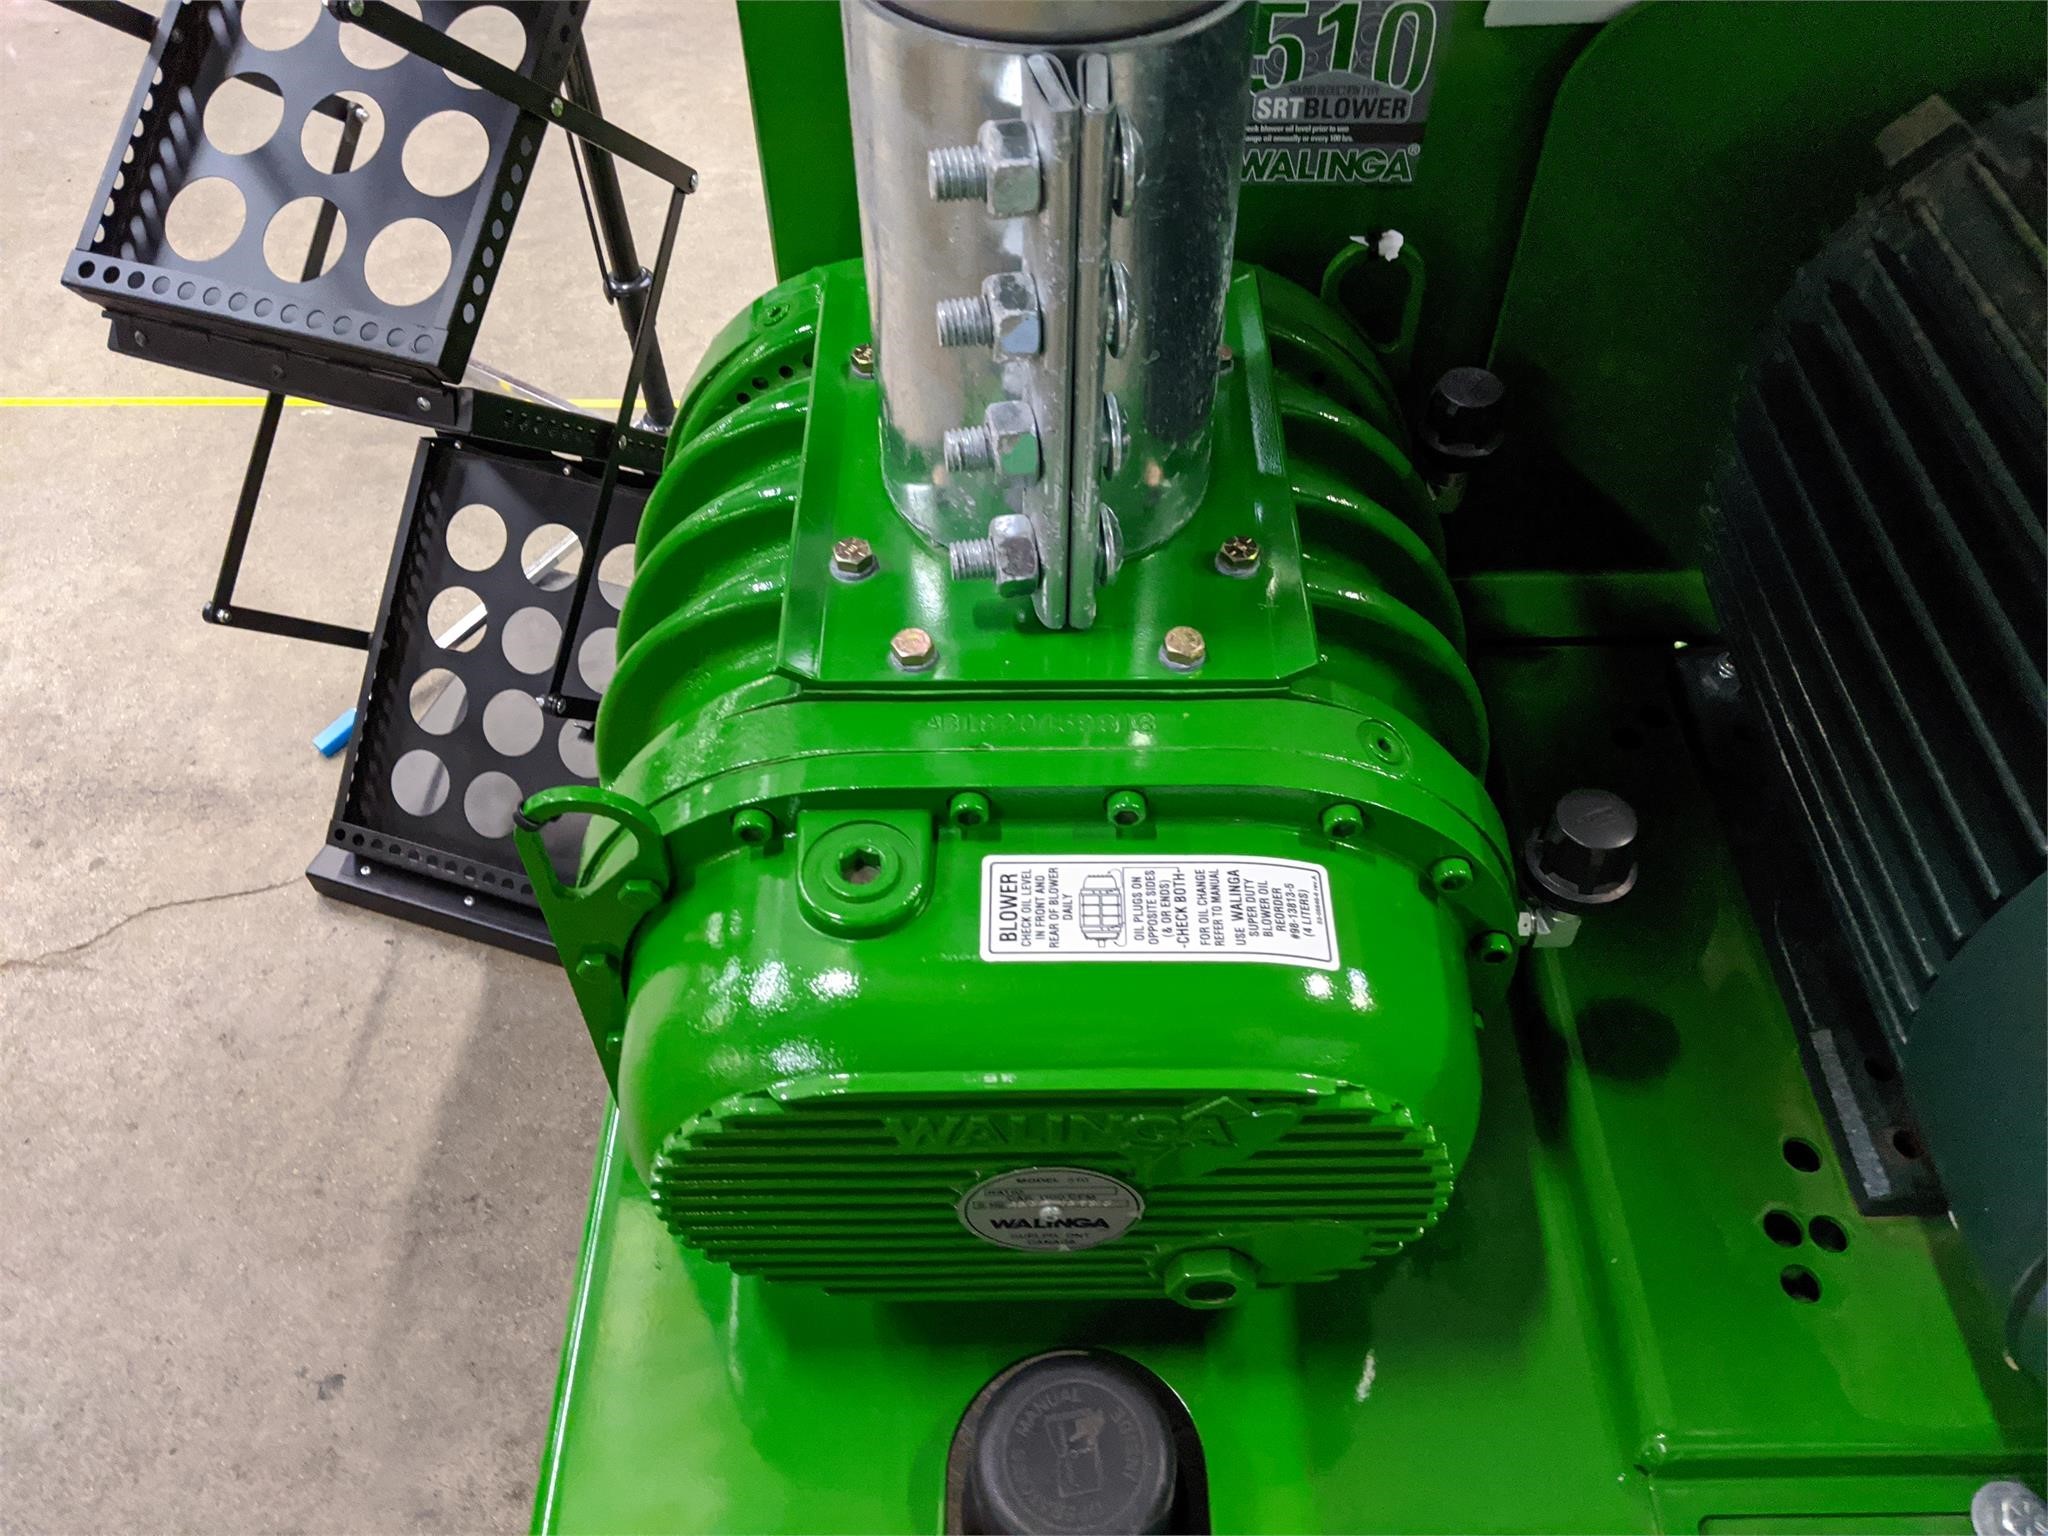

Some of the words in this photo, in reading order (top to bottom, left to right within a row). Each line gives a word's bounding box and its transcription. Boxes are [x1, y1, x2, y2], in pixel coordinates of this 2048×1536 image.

[1250, 1, 1437, 95] 510
[1310, 136, 1328, 144] every
[1312, 126, 1328, 134] prior
[1021, 869, 1031, 895] LEVEL
[1035, 875, 1045, 894] AND
[1048, 867, 1058, 905] BLOWER
[1131, 876, 1142, 889] ON
[1145, 870, 1156, 896] SIDES
[1160, 880, 1171, 908] ENDS)
[1195, 869, 1207, 905] CHANGE
[1209, 869, 1221, 903] MANUAL
[1244, 878, 1256, 903] DUTY
[1258, 880, 1268, 895] OIL
[999, 874, 1018, 942] BLOWER
[1022, 899, 1031, 913] OIL
[1062, 894, 1072, 920] DAILY
[1132, 892, 1143, 922] PLUGS
[1227, 870, 1243, 921] WALINGA
[1298, 889, 1312, 924] LITERS)
[1035, 897, 1045, 927] FRONT
[1049, 908, 1059, 920] OF
[1147, 899, 1159, 944] OPPOSITE
[1161, 910, 1171, 923] OR
[1198, 910, 1209, 924] OIL
[1211, 906, 1222, 917] TO
[1246, 906, 1259, 937] SUPER
[1260, 898, 1273, 937] BLOWER
[1272, 887, 1286, 931] REORDER
[1284, 883, 1300, 939] #98-13813-5
[1022, 916, 1032, 947] CHECK
[1035, 931, 1045, 940] IN
[1049, 924, 1059, 948] REAR
[1134, 926, 1144, 941] OIL
[1199, 927, 1210, 946] FOR
[1213, 920, 1223, 946] REFER
[1234, 927, 1246, 945] USE
[1303, 928, 1315, 937] (4
[885, 1113, 1240, 1149] WALINGA
[990, 1217, 1110, 1229] WALINGA
